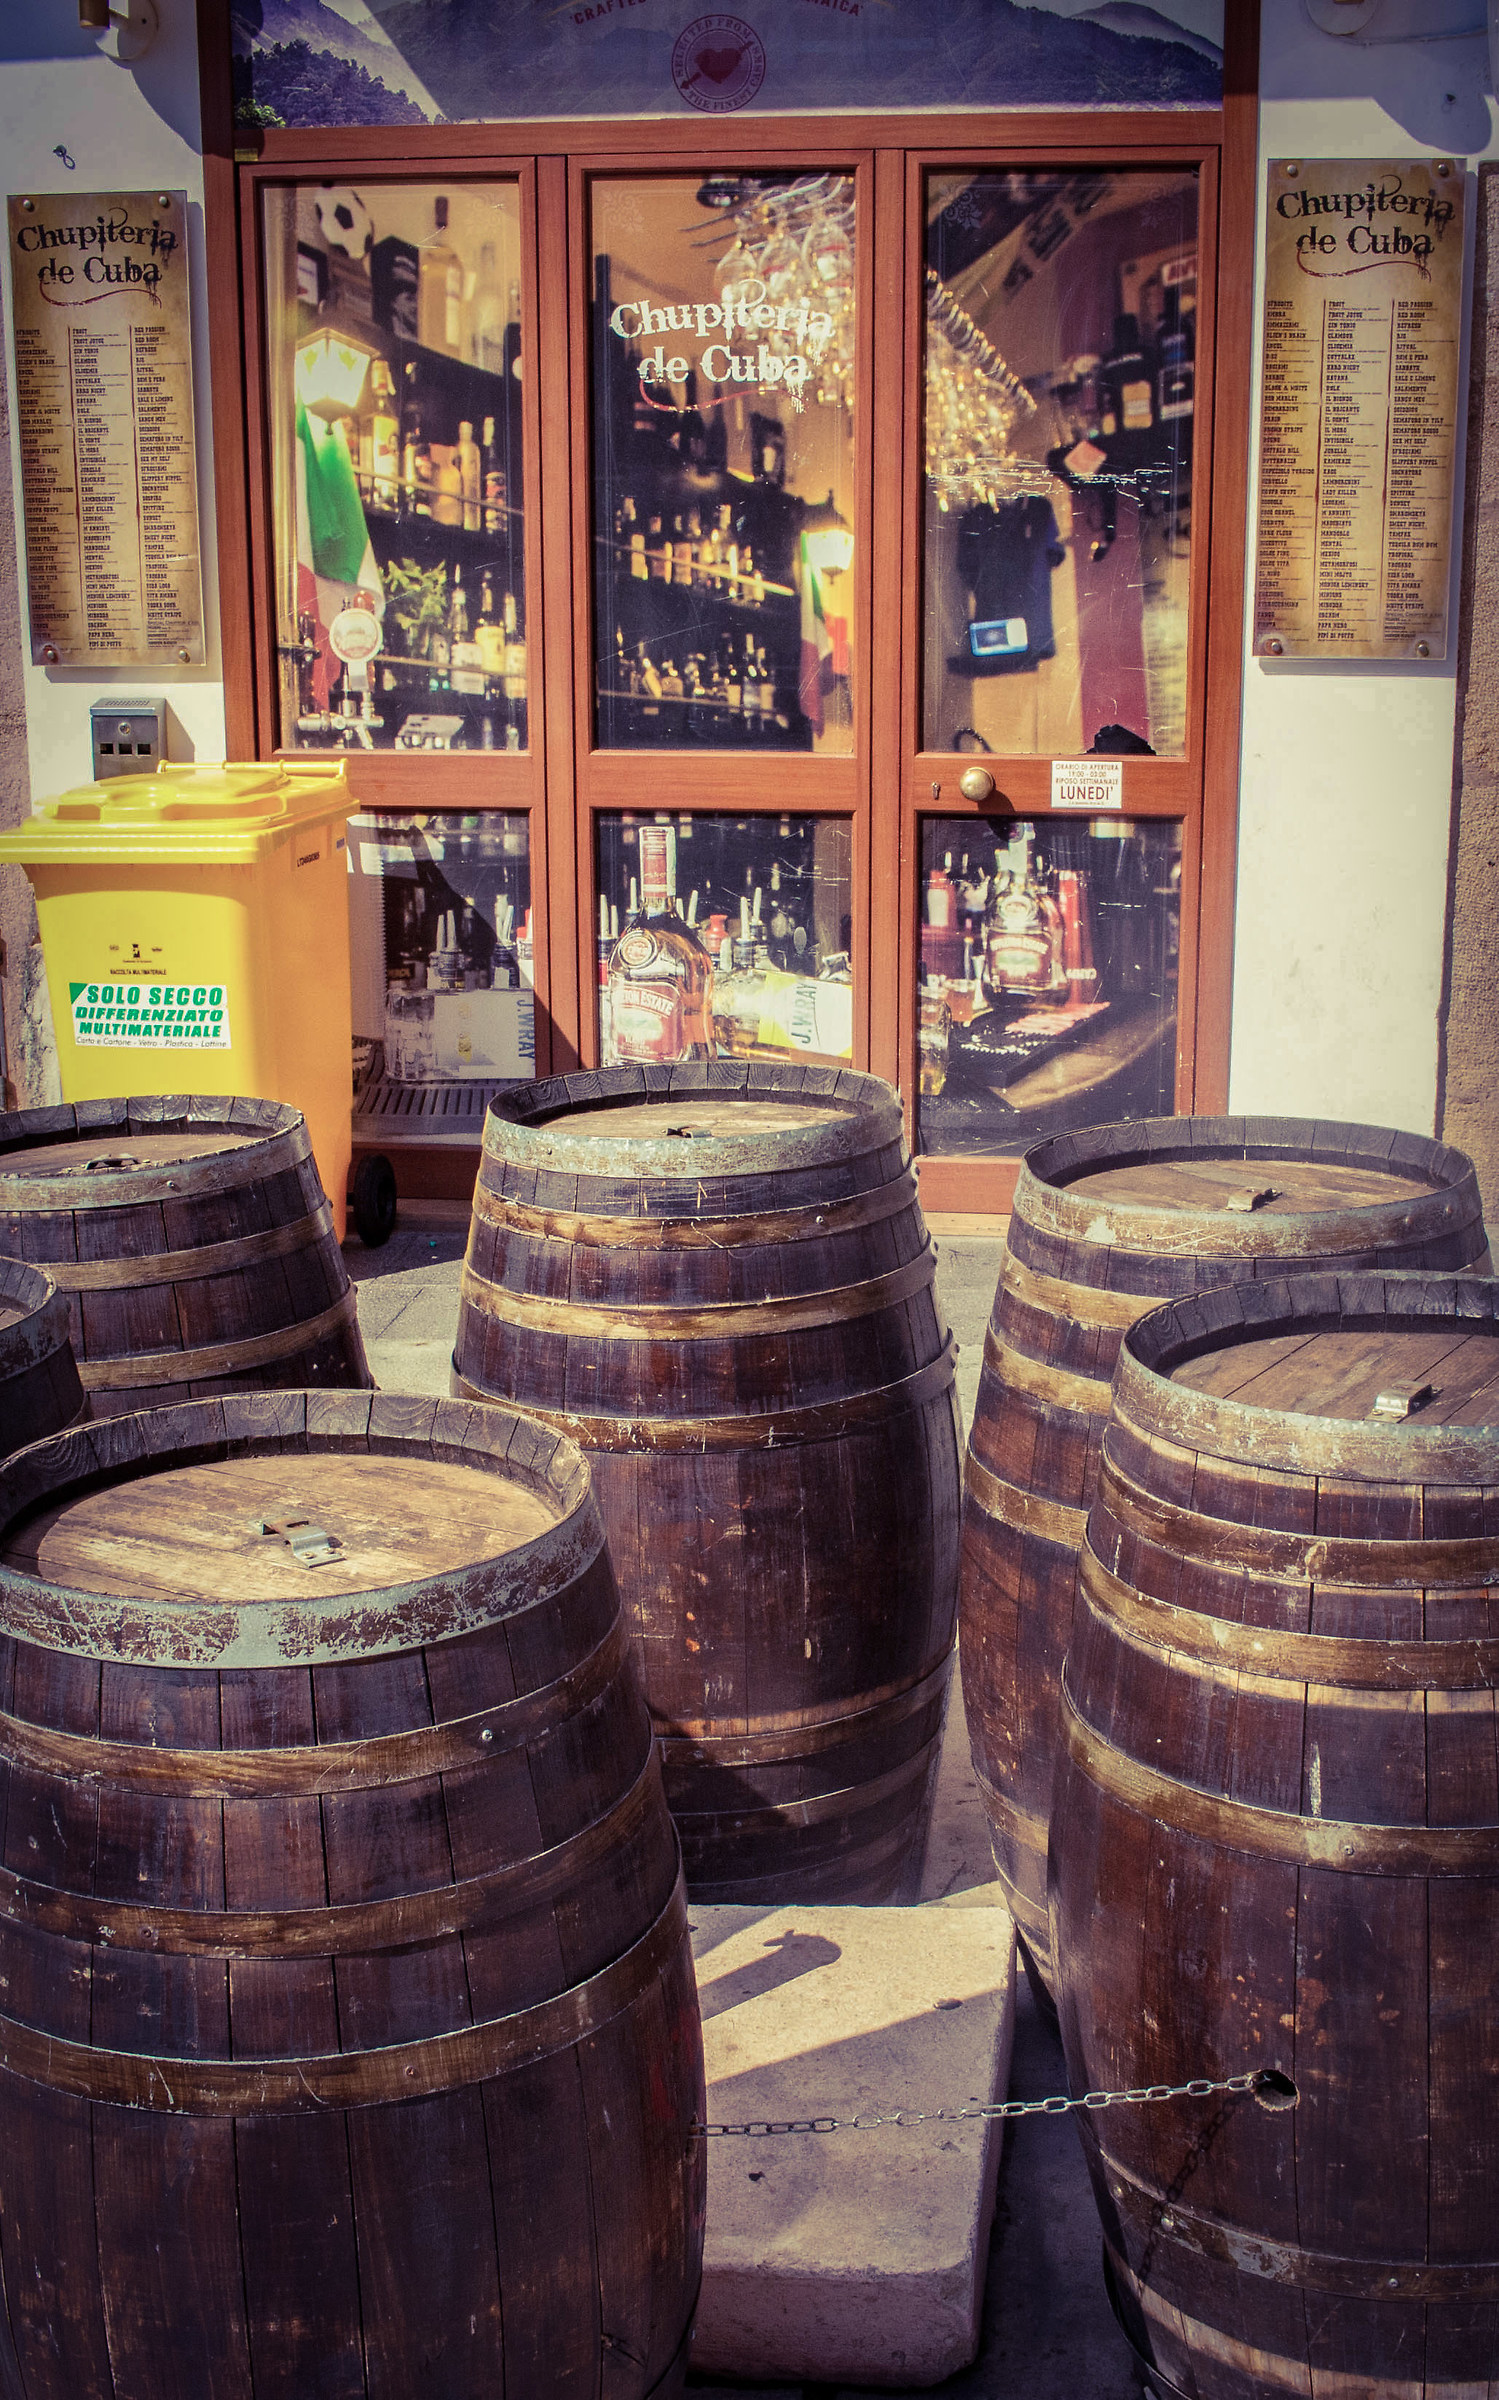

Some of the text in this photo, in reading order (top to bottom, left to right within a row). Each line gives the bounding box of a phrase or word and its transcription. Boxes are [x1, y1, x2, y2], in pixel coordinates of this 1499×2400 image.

[675, 17, 752, 77] SELECTED FROM
[1276, 175, 1456, 225] Chupiteria
[17, 207, 178, 256] Chupiteria
[1296, 225, 1435, 257] de Cuba
[38, 256, 162, 288] de Cuba
[609, 280, 836, 346] Chupiteria
[637, 344, 812, 384] de Cuba
[1055, 777, 1078, 785] RIPOSO
[1060, 786, 1113, 800] LUNEDI'
[87, 985, 223, 1006] SOLO SECCO
[641, 990, 675, 1017] ESTATE
[75, 1006, 224, 1022] DIFFERENZIATO
[79, 1022, 221, 1038] MULTIMATERIALE
